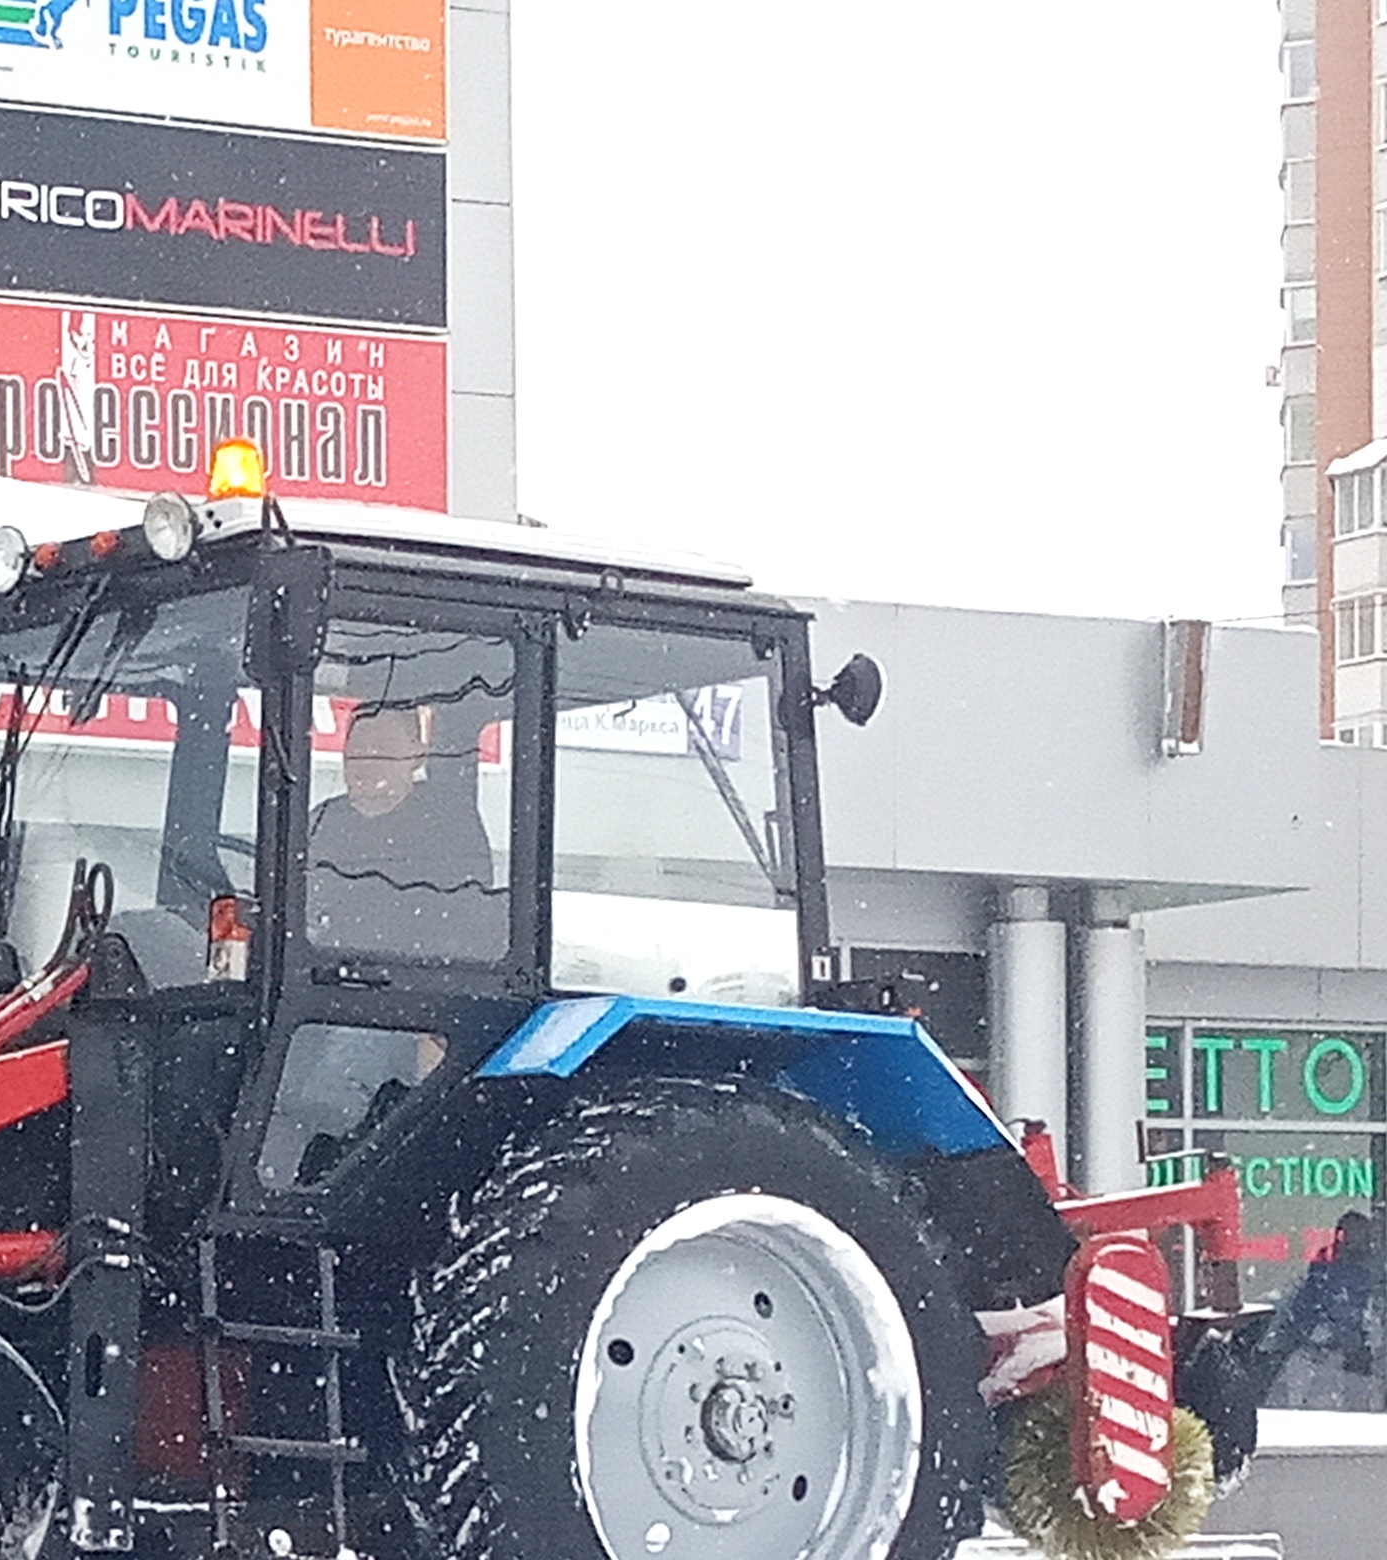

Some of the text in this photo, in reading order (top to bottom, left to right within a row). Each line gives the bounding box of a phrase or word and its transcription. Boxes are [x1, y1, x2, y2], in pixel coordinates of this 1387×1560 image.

[108, 0, 268, 53] PEGAS
[323, 27, 430, 52] турагентство
[108, 43, 266, 72] TOURISTIK
[184, 359, 238, 391] ДЛЯ
[257, 365, 385, 401] КРАСОТЫ
[690, 685, 742, 746] 47
